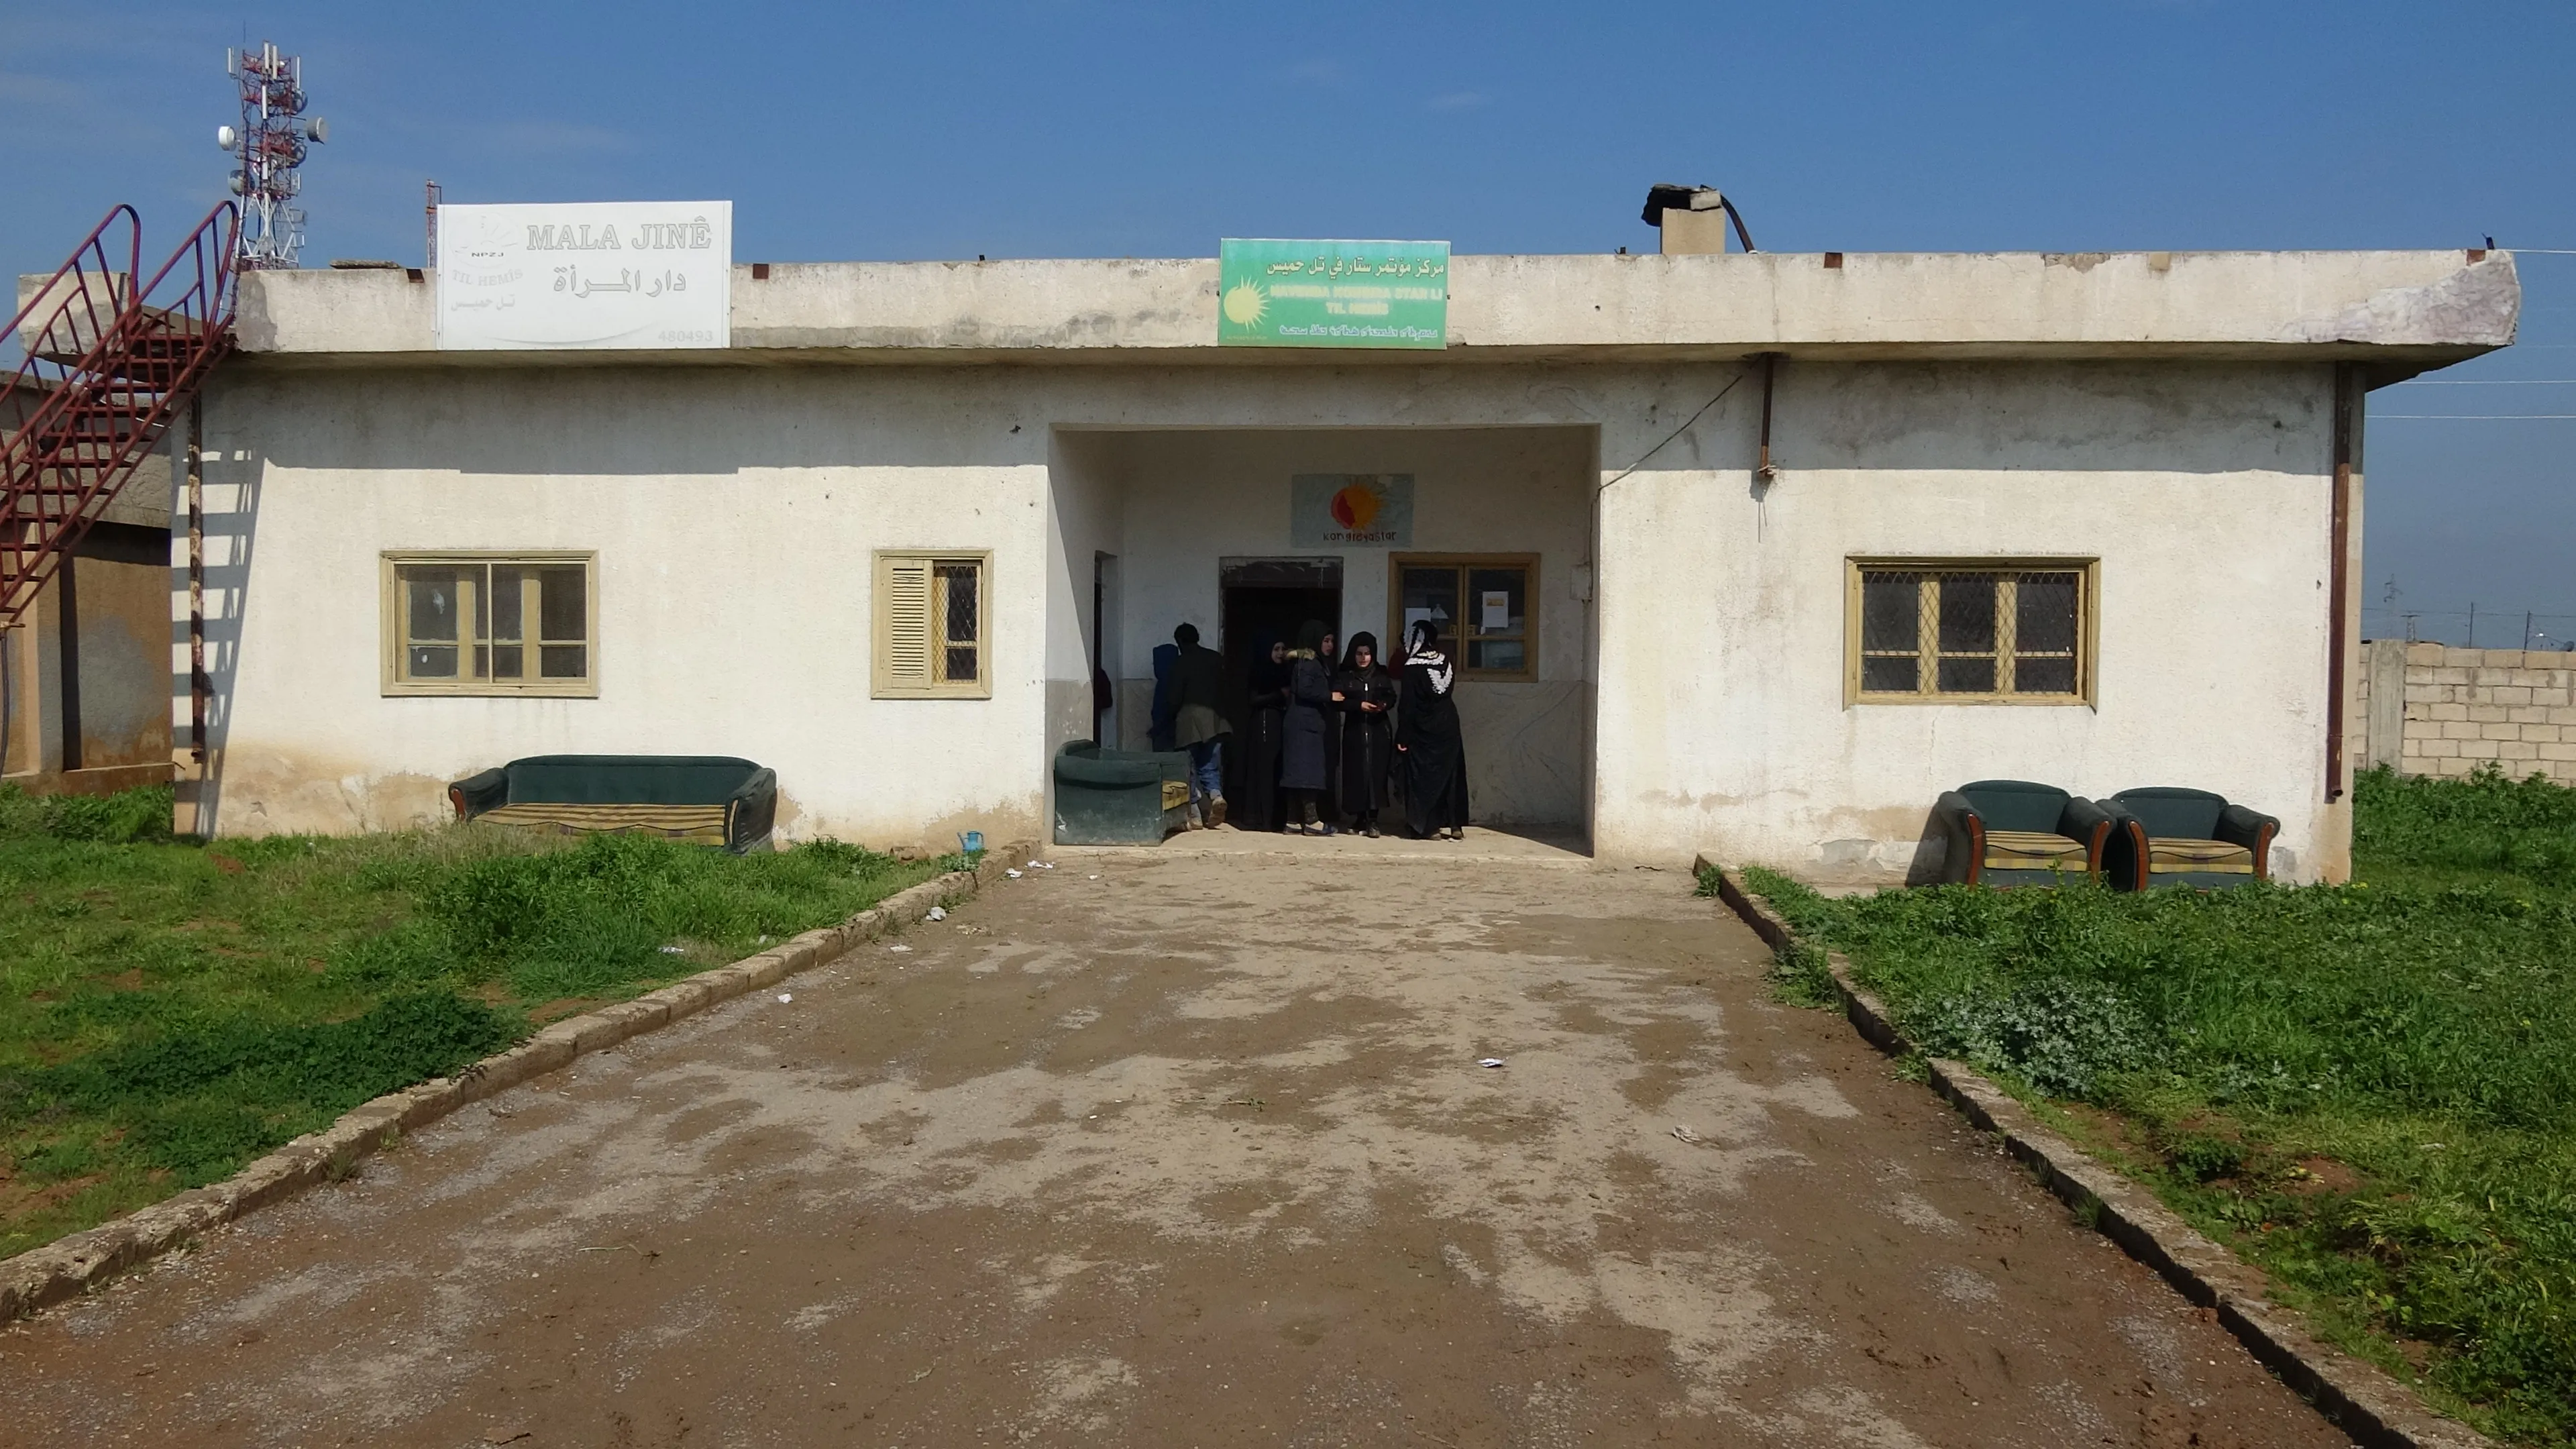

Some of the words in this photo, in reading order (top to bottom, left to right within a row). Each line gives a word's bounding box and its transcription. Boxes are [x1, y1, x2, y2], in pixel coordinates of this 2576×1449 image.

[527, 225, 622, 250] MALA
[631, 216, 712, 250] JINÊ
[1266, 260, 1305, 276] حميس
[1307, 255, 1326, 276] تل
[1328, 256, 1344, 280] في
[1346, 256, 1372, 276] ستار
[1375, 256, 1411, 277] مؤتمر
[1414, 258, 1445, 278] مركز
[451, 269, 474, 286] TIL
[645, 269, 687, 297] دار
[451, 298, 494, 312] حميس
[496, 293, 516, 311] تل
[657, 329, 714, 342] 480493
